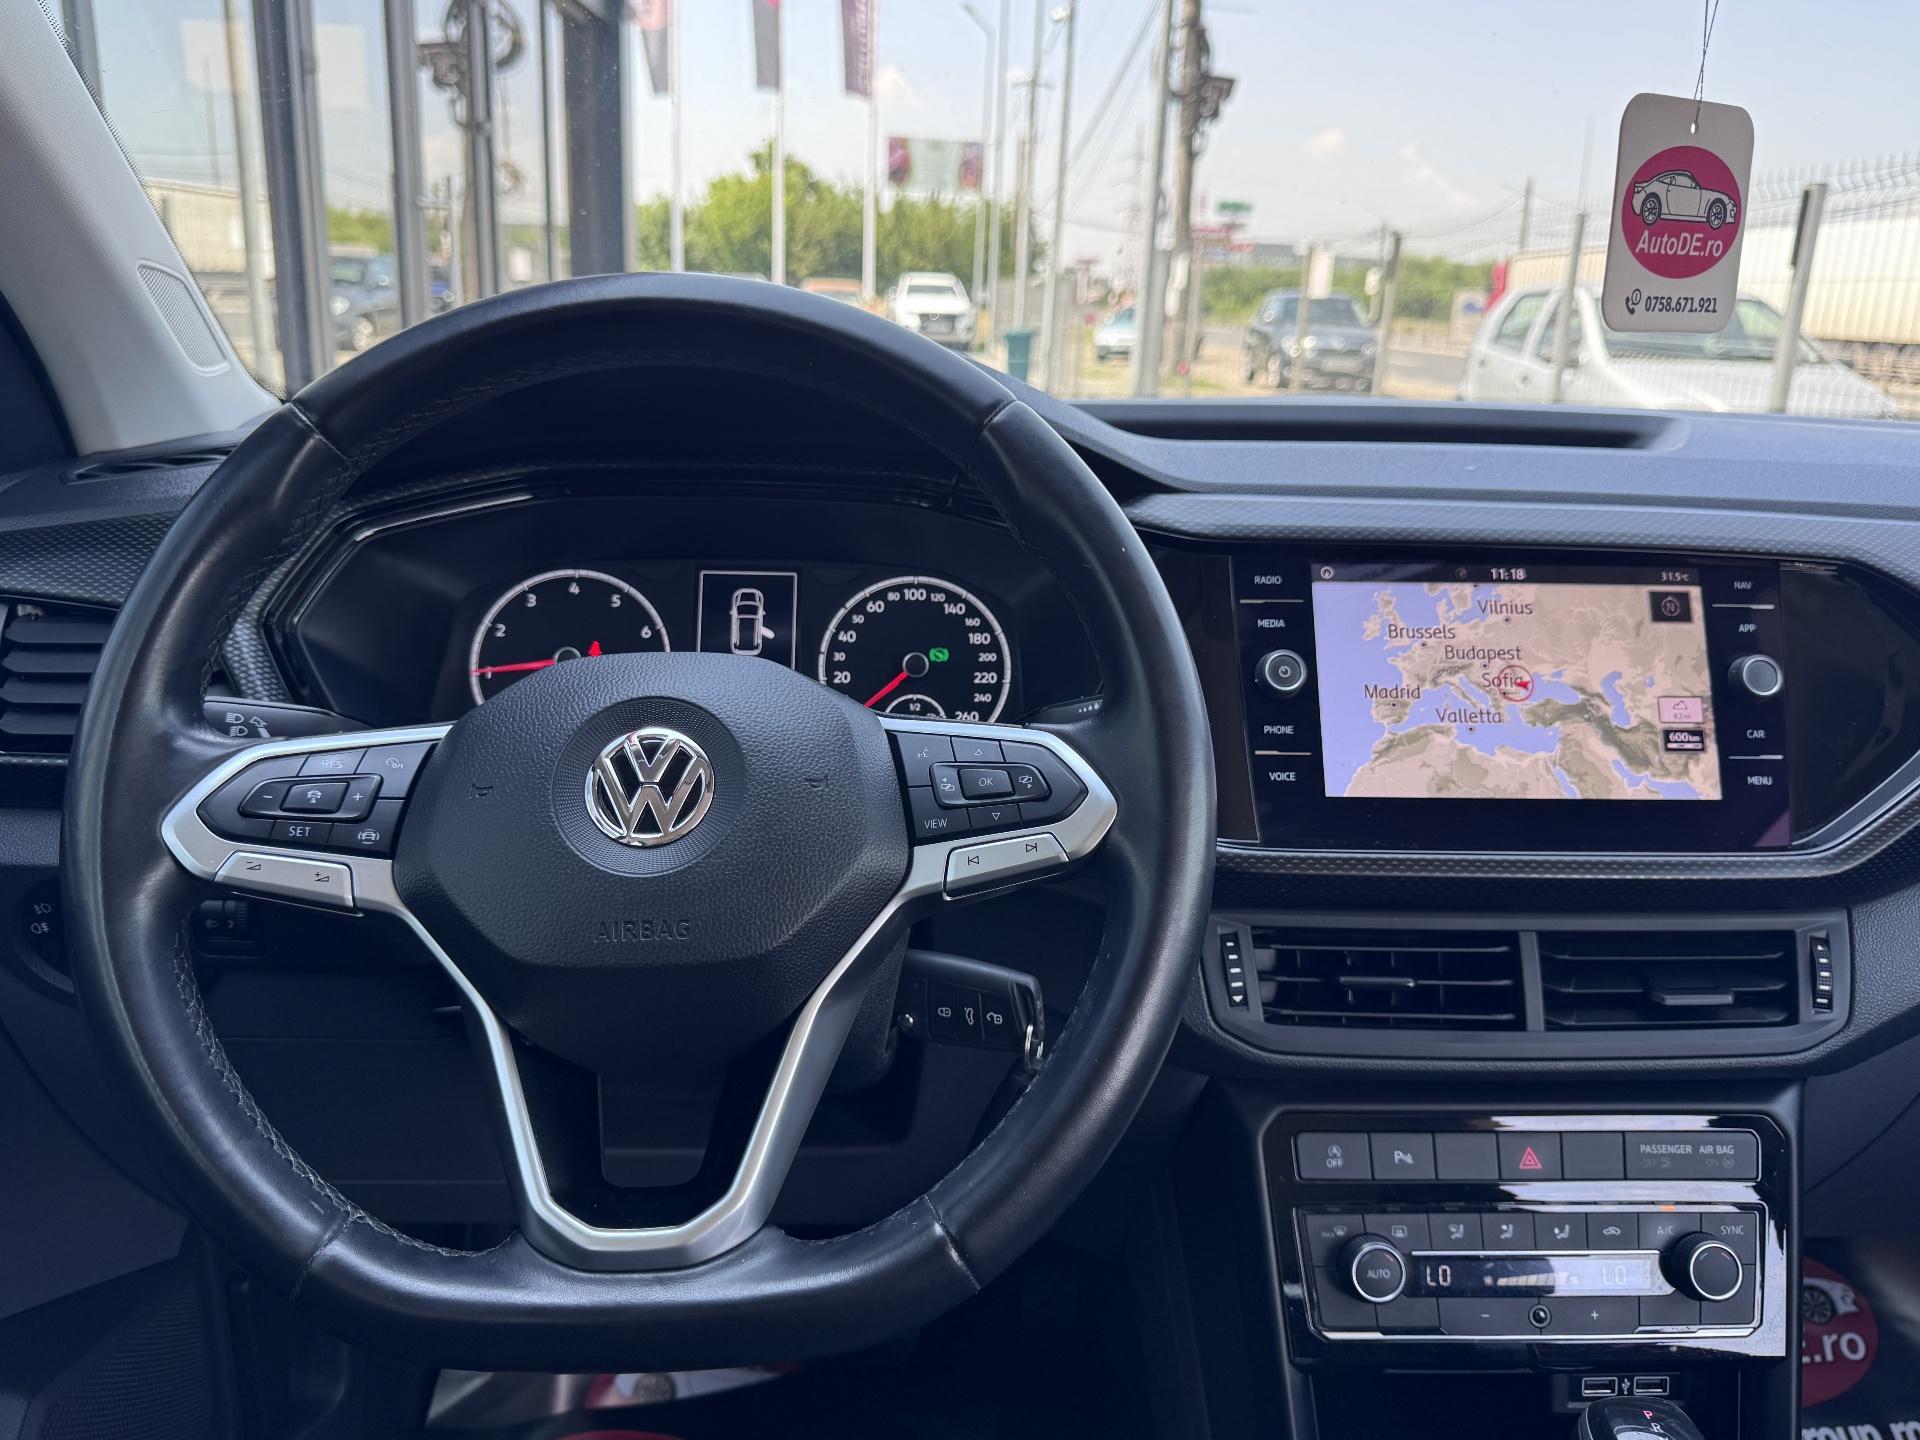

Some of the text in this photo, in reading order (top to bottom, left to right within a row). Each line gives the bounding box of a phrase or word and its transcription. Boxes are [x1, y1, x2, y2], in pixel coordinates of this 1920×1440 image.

[1636, 230, 1723, 257] AutoDE.ro
[1645, 295, 1718, 313] 0758.671.921
[1490, 568, 1527, 580] 11:18
[1254, 575, 1283, 585] RADIO
[1734, 581, 1752, 590] NAV
[568, 582, 580, 595] 4
[887, 591, 900, 601] 80
[903, 588, 927, 601] 100
[930, 592, 946, 602] 120
[525, 593, 537, 608] 3
[611, 594, 621, 608] 5
[866, 600, 884, 613] 60
[943, 603, 966, 616] 140
[1477, 599, 1534, 615] Vilnius
[852, 614, 865, 624] 50
[965, 617, 981, 627] 160
[1257, 618, 1286, 628] MEDIA
[495, 623, 506, 637] 2
[640, 625, 652, 639] 6
[1388, 623, 1456, 640] Brussels
[1738, 623, 1756, 633] APP
[838, 630, 857, 643] 40
[968, 632, 991, 645] 180
[833, 652, 846, 662] 30
[978, 652, 997, 662] 200
[1445, 645, 1522, 664] Budapest
[833, 671, 851, 684] 20
[974, 671, 998, 684] 220
[974, 692, 992, 703] 240
[1364, 684, 1421, 700] Madrid
[955, 711, 979, 722] 260
[1435, 708, 1502, 724] Valletta
[1264, 725, 1295, 735] PHONE
[1747, 730, 1765, 739] CAR
[1269, 771, 1296, 781] VOICE
[1747, 776, 1772, 786] MENU
[979, 777, 994, 787] OK
[924, 818, 948, 829] VIEW
[289, 826, 311, 837] SET
[595, 919, 690, 943] AIRBAG
[1640, 1144, 1735, 1155] PASSENGER AIR BAG
[1657, 1226, 1675, 1236] A/C
[1720, 1225, 1745, 1236] SYNC
[1367, 1269, 1391, 1279] AUTO
[1643, 1410, 1653, 1420] P
[1650, 1422, 1663, 1433] R
